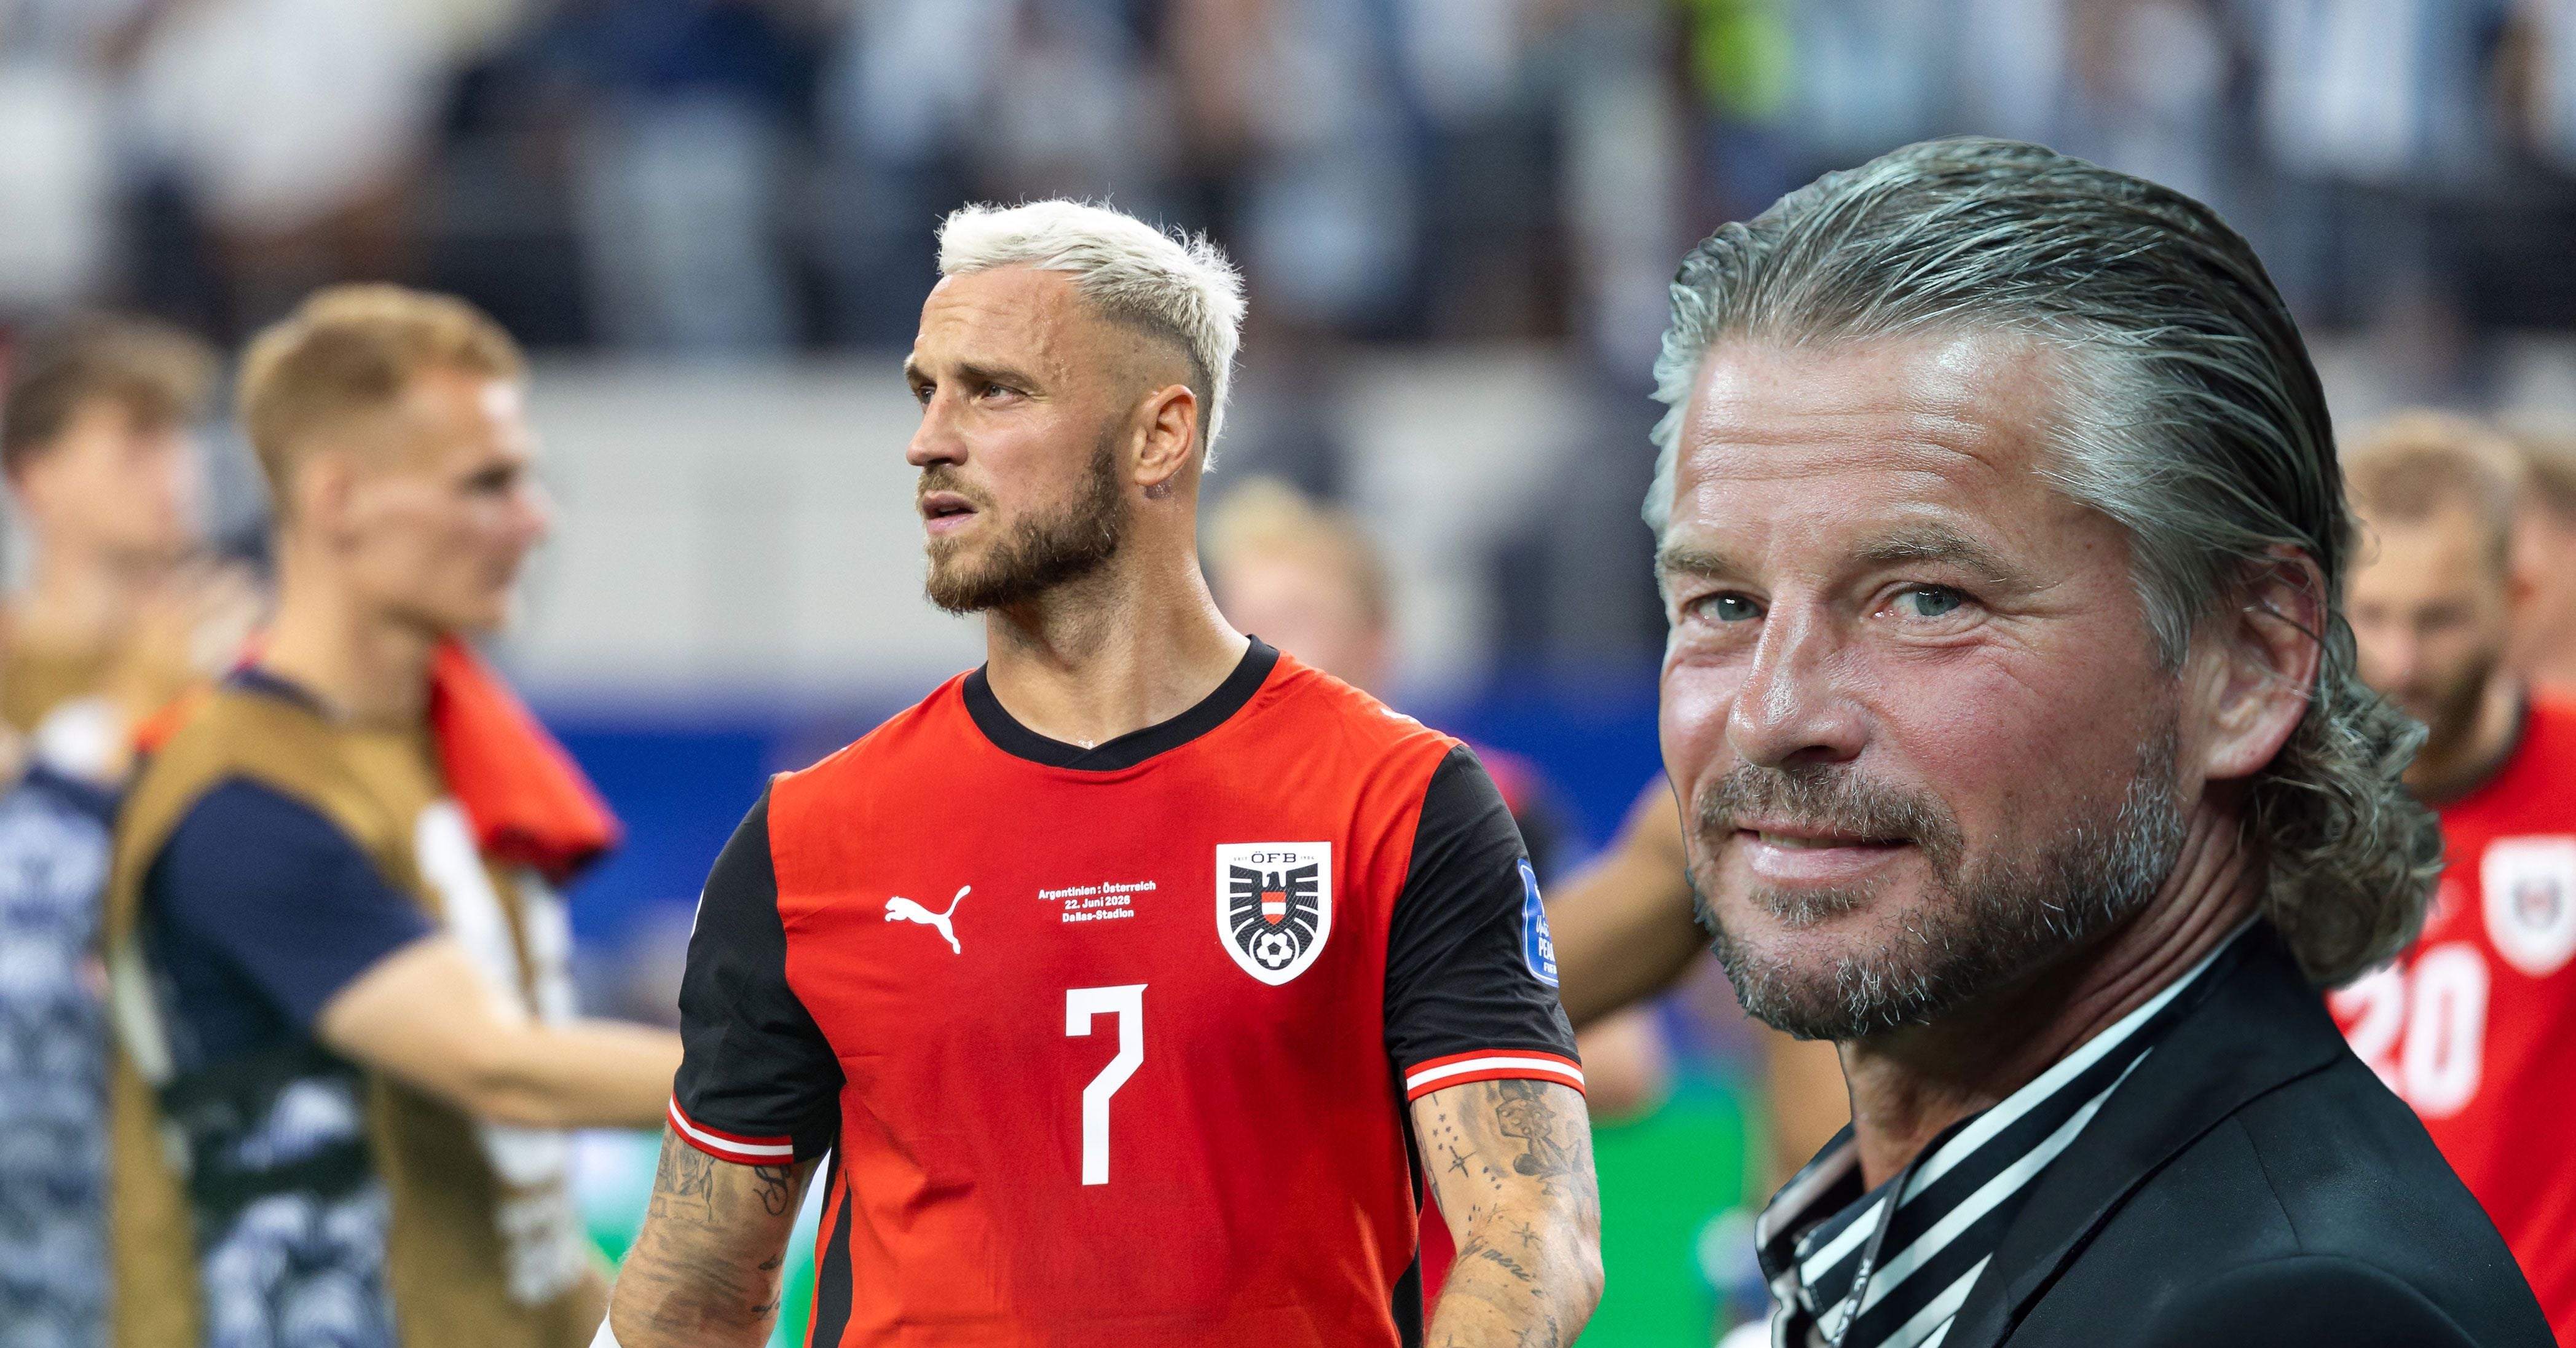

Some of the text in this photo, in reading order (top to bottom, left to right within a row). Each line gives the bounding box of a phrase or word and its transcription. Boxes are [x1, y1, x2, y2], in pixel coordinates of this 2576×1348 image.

[1251, 851, 1296, 863] ÖFB
[1038, 885, 1096, 901] Argentinien
[1103, 880, 1156, 893] Österreich
[1065, 895, 1130, 910] 22. Juni 2026
[1062, 908, 1135, 922] Dallas-Stadion
[1066, 983, 1149, 1186] 7
